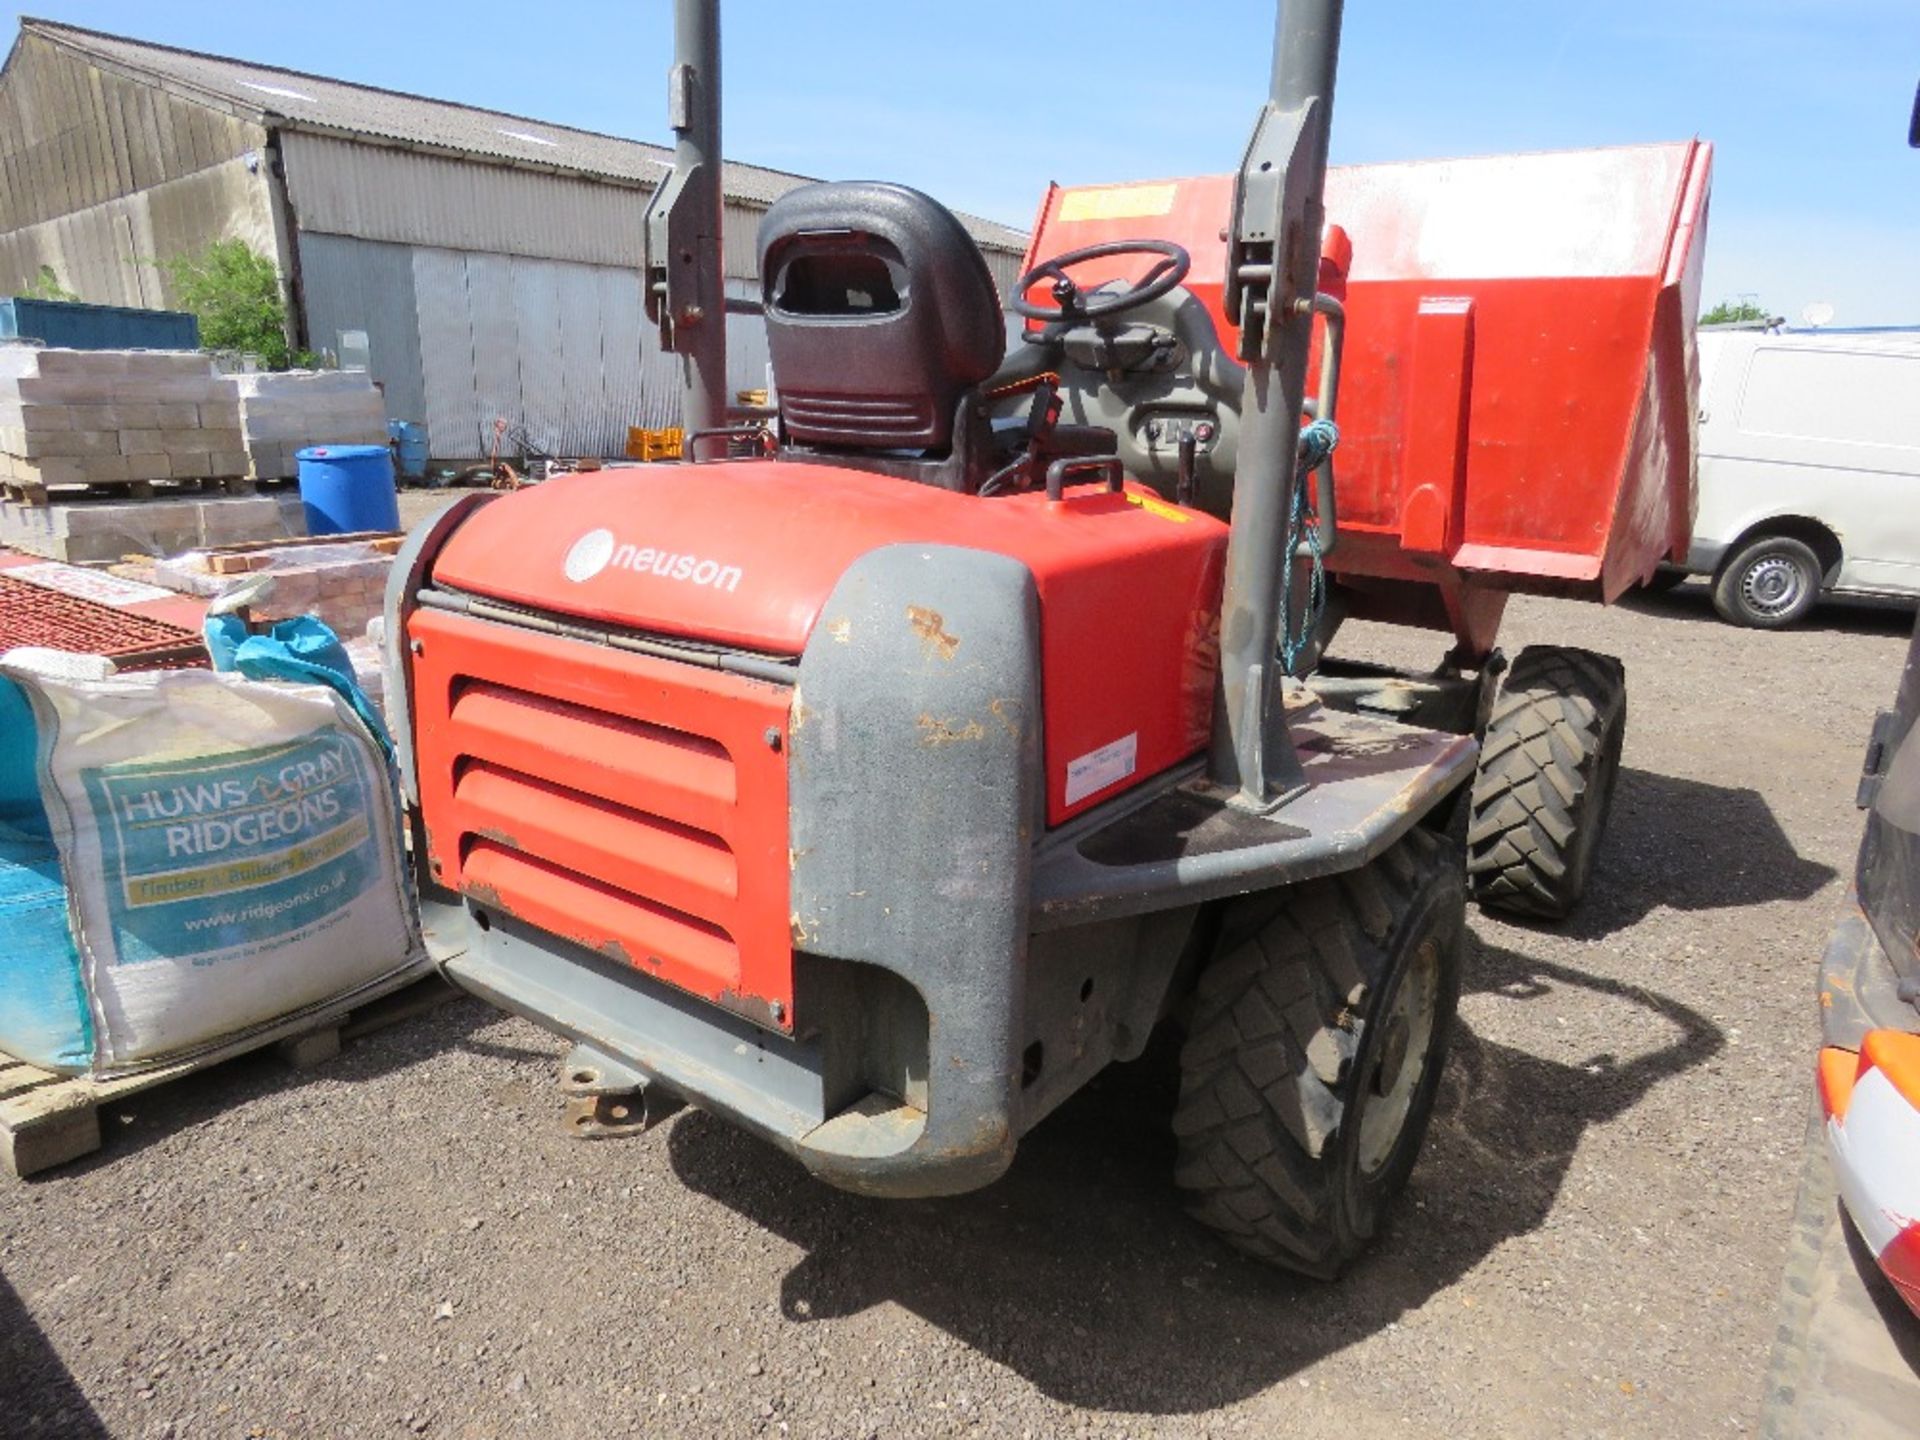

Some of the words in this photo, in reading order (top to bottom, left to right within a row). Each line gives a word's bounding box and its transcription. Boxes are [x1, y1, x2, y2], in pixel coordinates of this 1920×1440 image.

[611, 543, 743, 593] neuson
[121, 780, 250, 821] HUWS
[278, 744, 346, 792] GRAY
[166, 788, 340, 858] RIDGEONS
